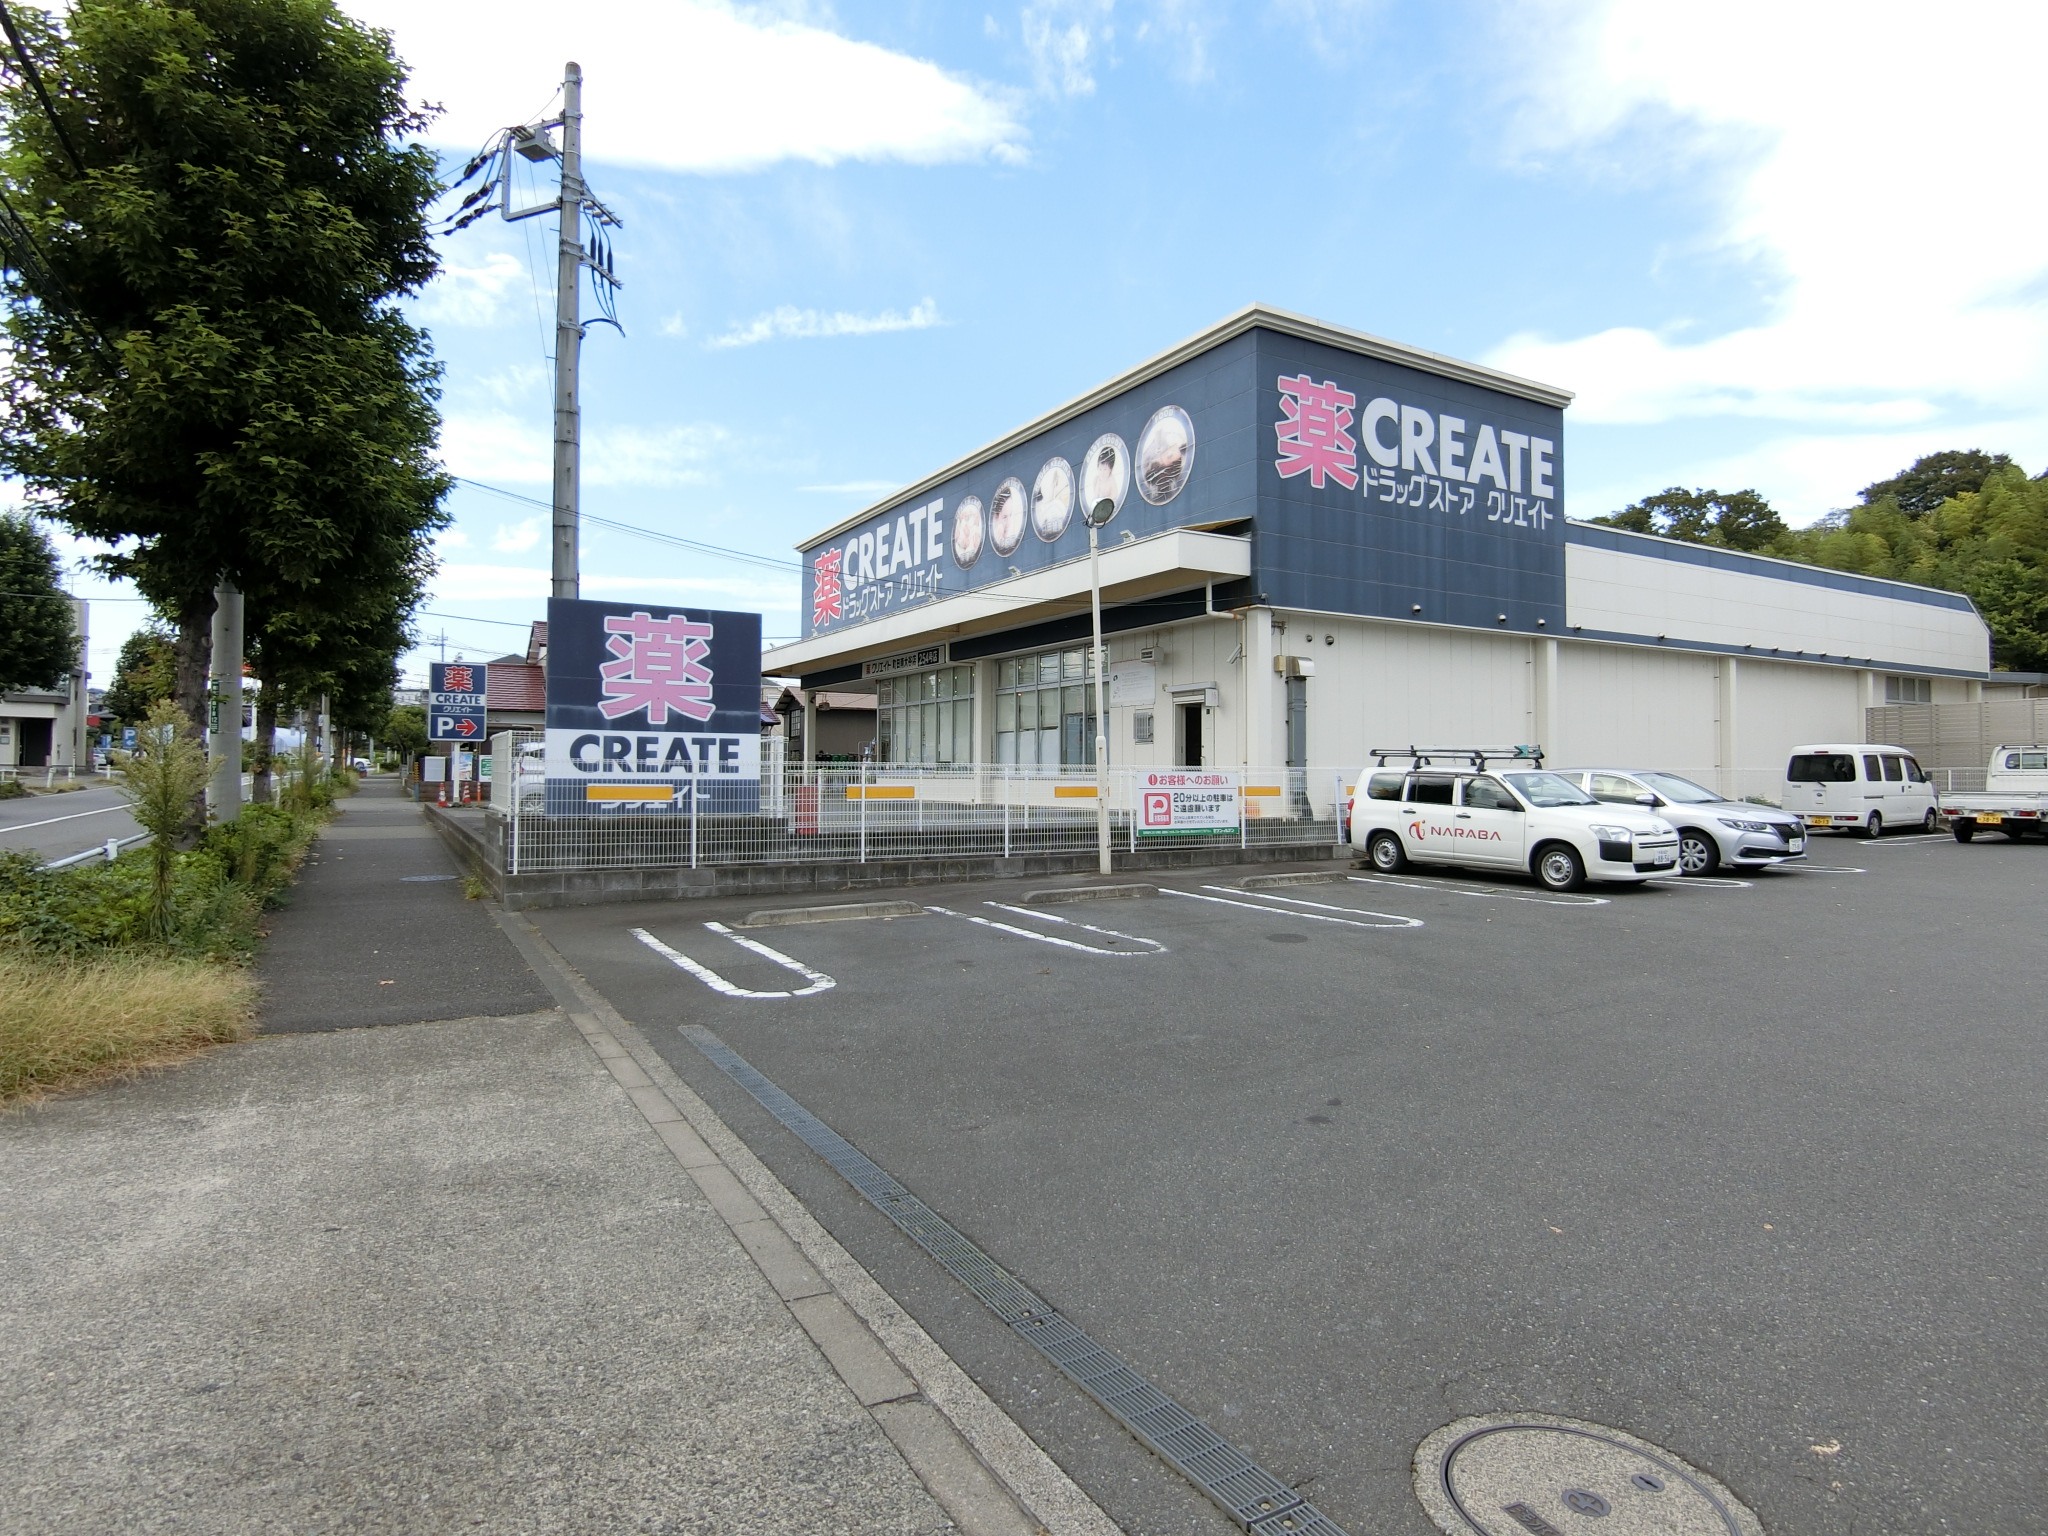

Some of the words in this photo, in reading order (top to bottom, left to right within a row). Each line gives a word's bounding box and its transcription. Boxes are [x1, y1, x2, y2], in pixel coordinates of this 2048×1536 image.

[1275, 374, 1359, 491] 薬
[1361, 397, 1554, 499] CREATE
[1363, 465, 1475, 515] ドラッグストア
[1487, 490, 1554, 530] クリエイト
[843, 497, 944, 591] CREATE
[812, 548, 842, 627] 薬
[842, 581, 894, 621] ドラッグストア
[900, 563, 943, 603] クリエイト
[444, 666, 473, 692] 薬
[598, 612, 716, 725] 薬
[436, 694, 481, 705] CREATE
[443, 705, 473, 713] クリエイト
[124, 729, 136, 740] P
[437, 716, 454, 737] P
[569, 734, 740, 774] CREATE
[1158, 774, 1229, 786] お客様へのお願い
[1173, 792, 1233, 803] 20分以上の駐車は
[1173, 804, 1221, 813] ご遠慮願います
[1430, 826, 1501, 841] NARABA
